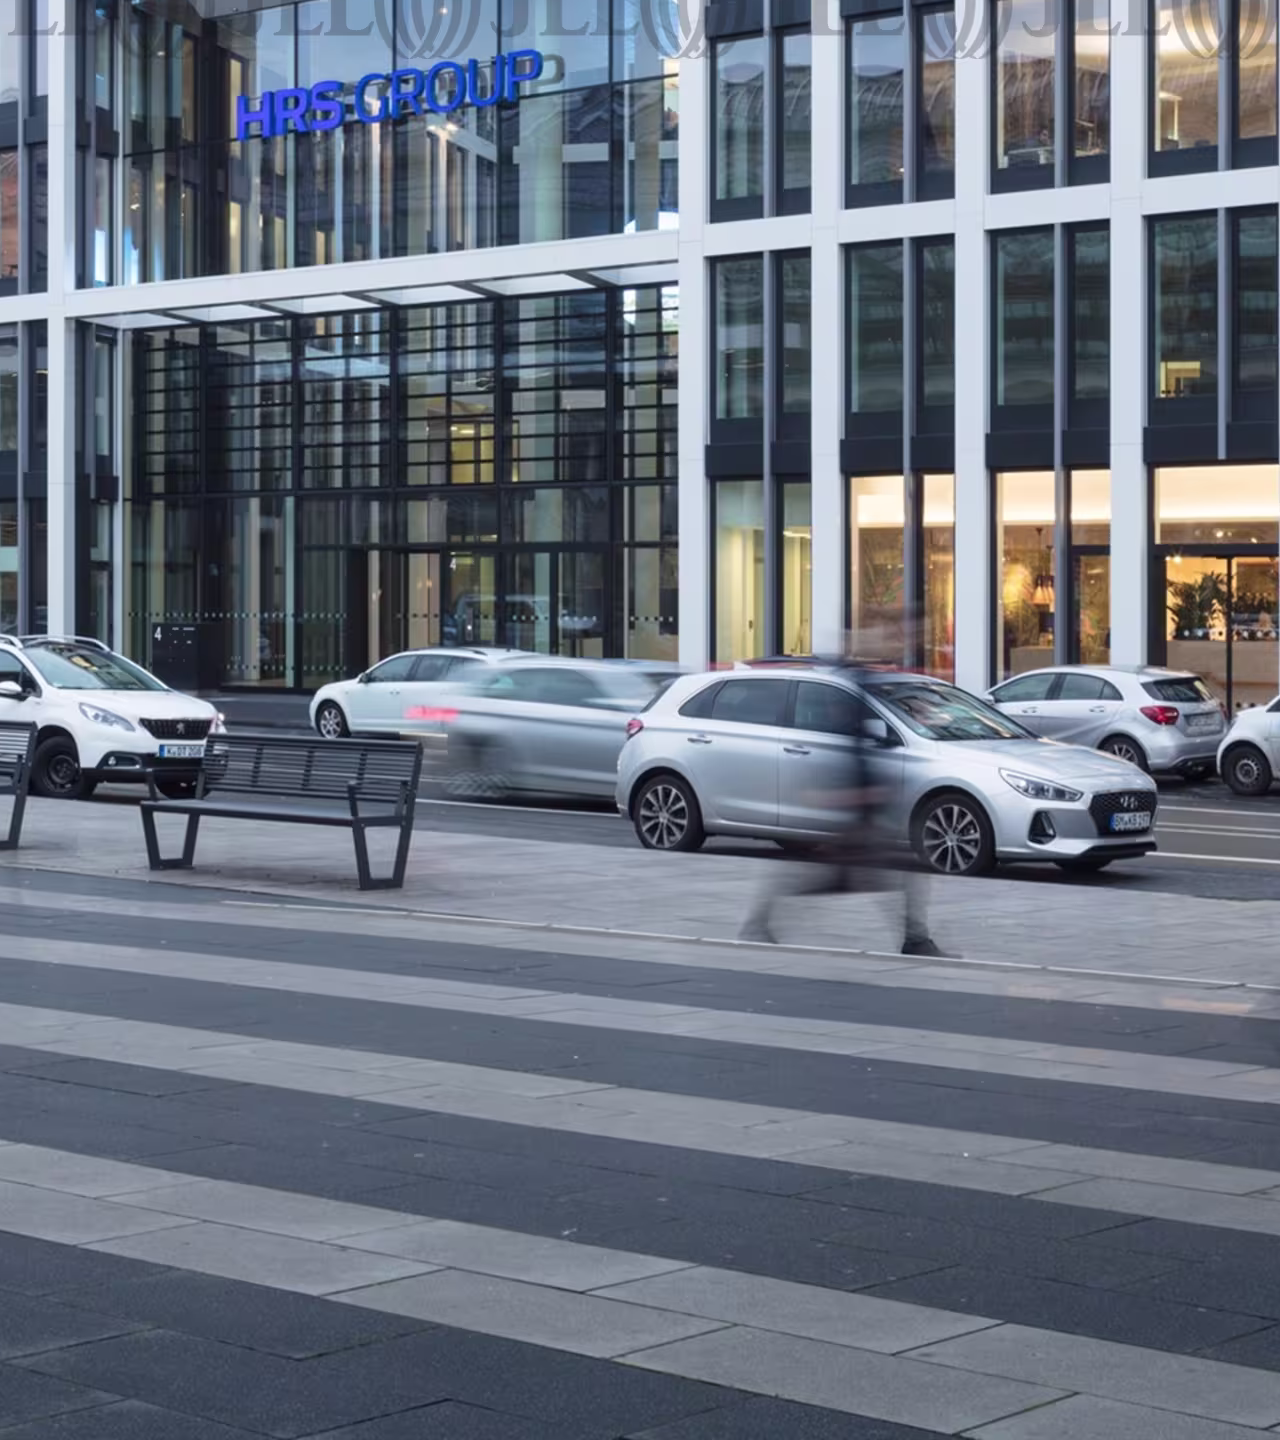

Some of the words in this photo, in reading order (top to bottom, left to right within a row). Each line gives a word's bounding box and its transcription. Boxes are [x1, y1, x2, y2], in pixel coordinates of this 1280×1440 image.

[236, 80, 345, 140] HRS
[354, 48, 543, 124] GROUP
[154, 626, 162, 641] 4
